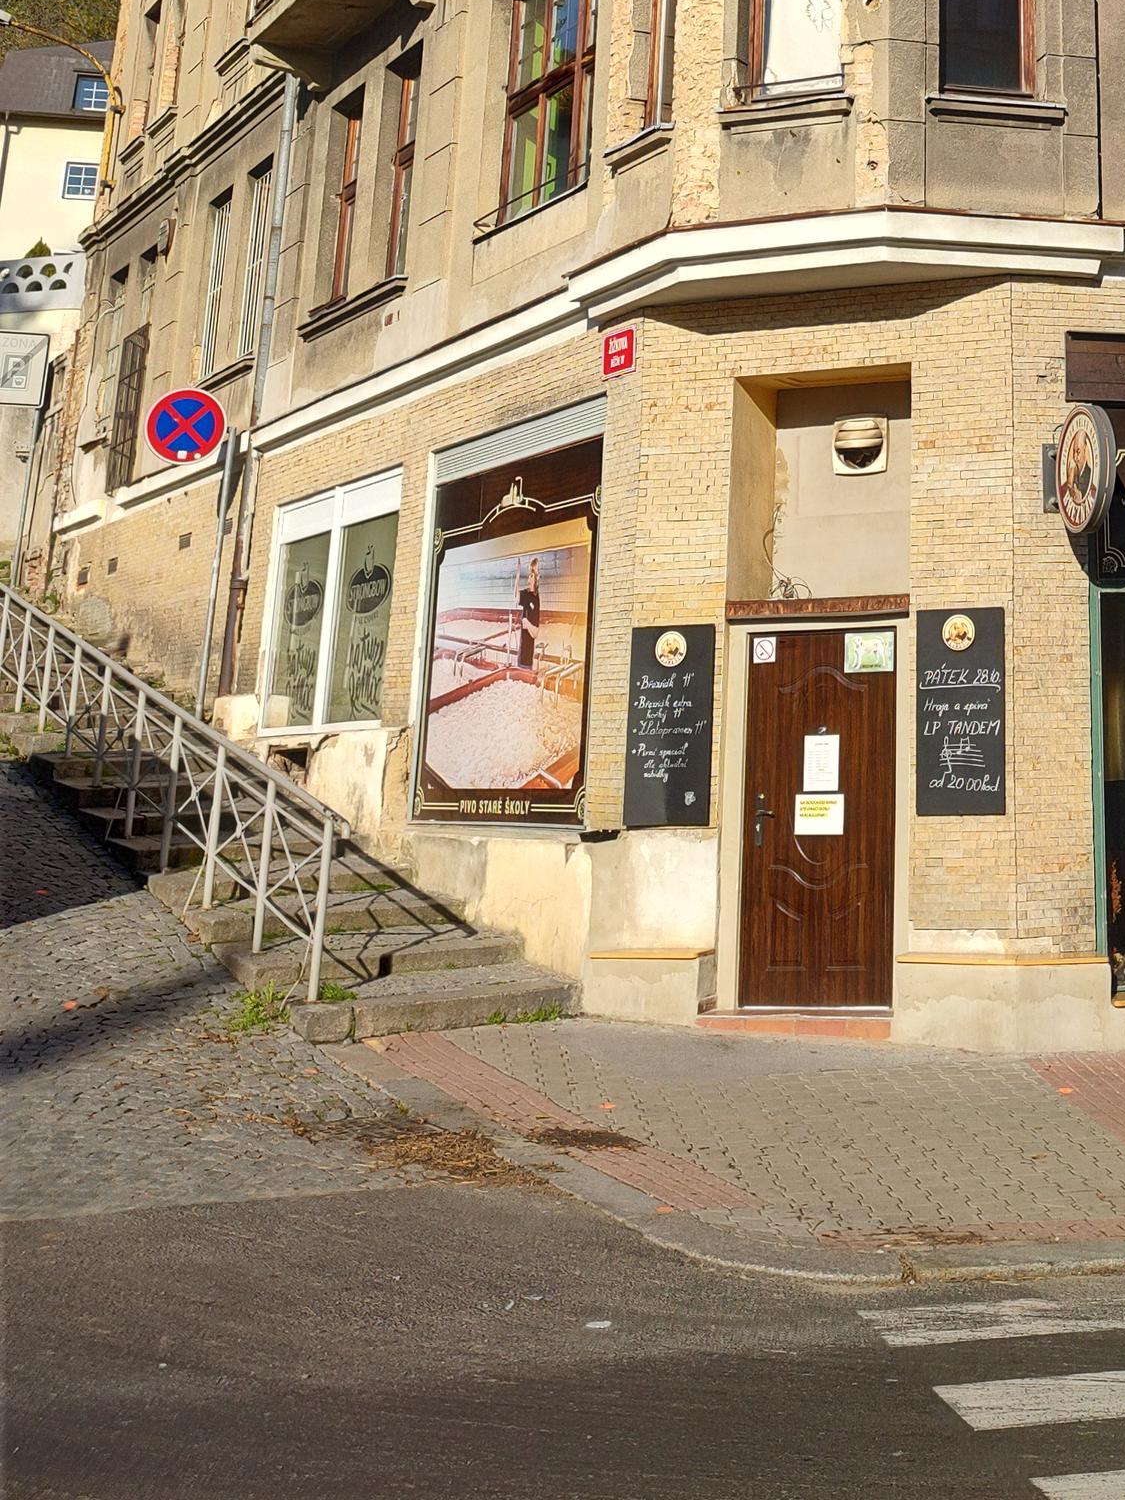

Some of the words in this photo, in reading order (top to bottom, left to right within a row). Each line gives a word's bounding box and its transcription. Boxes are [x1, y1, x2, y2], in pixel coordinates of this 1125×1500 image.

[923, 662, 969, 685] PÁTEK
[923, 721, 941, 735] LP
[947, 719, 1001, 735] TANDEM
[928, 772, 946, 788] od
[460, 800, 477, 814] PIVO
[479, 797, 502, 814] STARÉ
[504, 796, 531, 815] ŠKOLY
